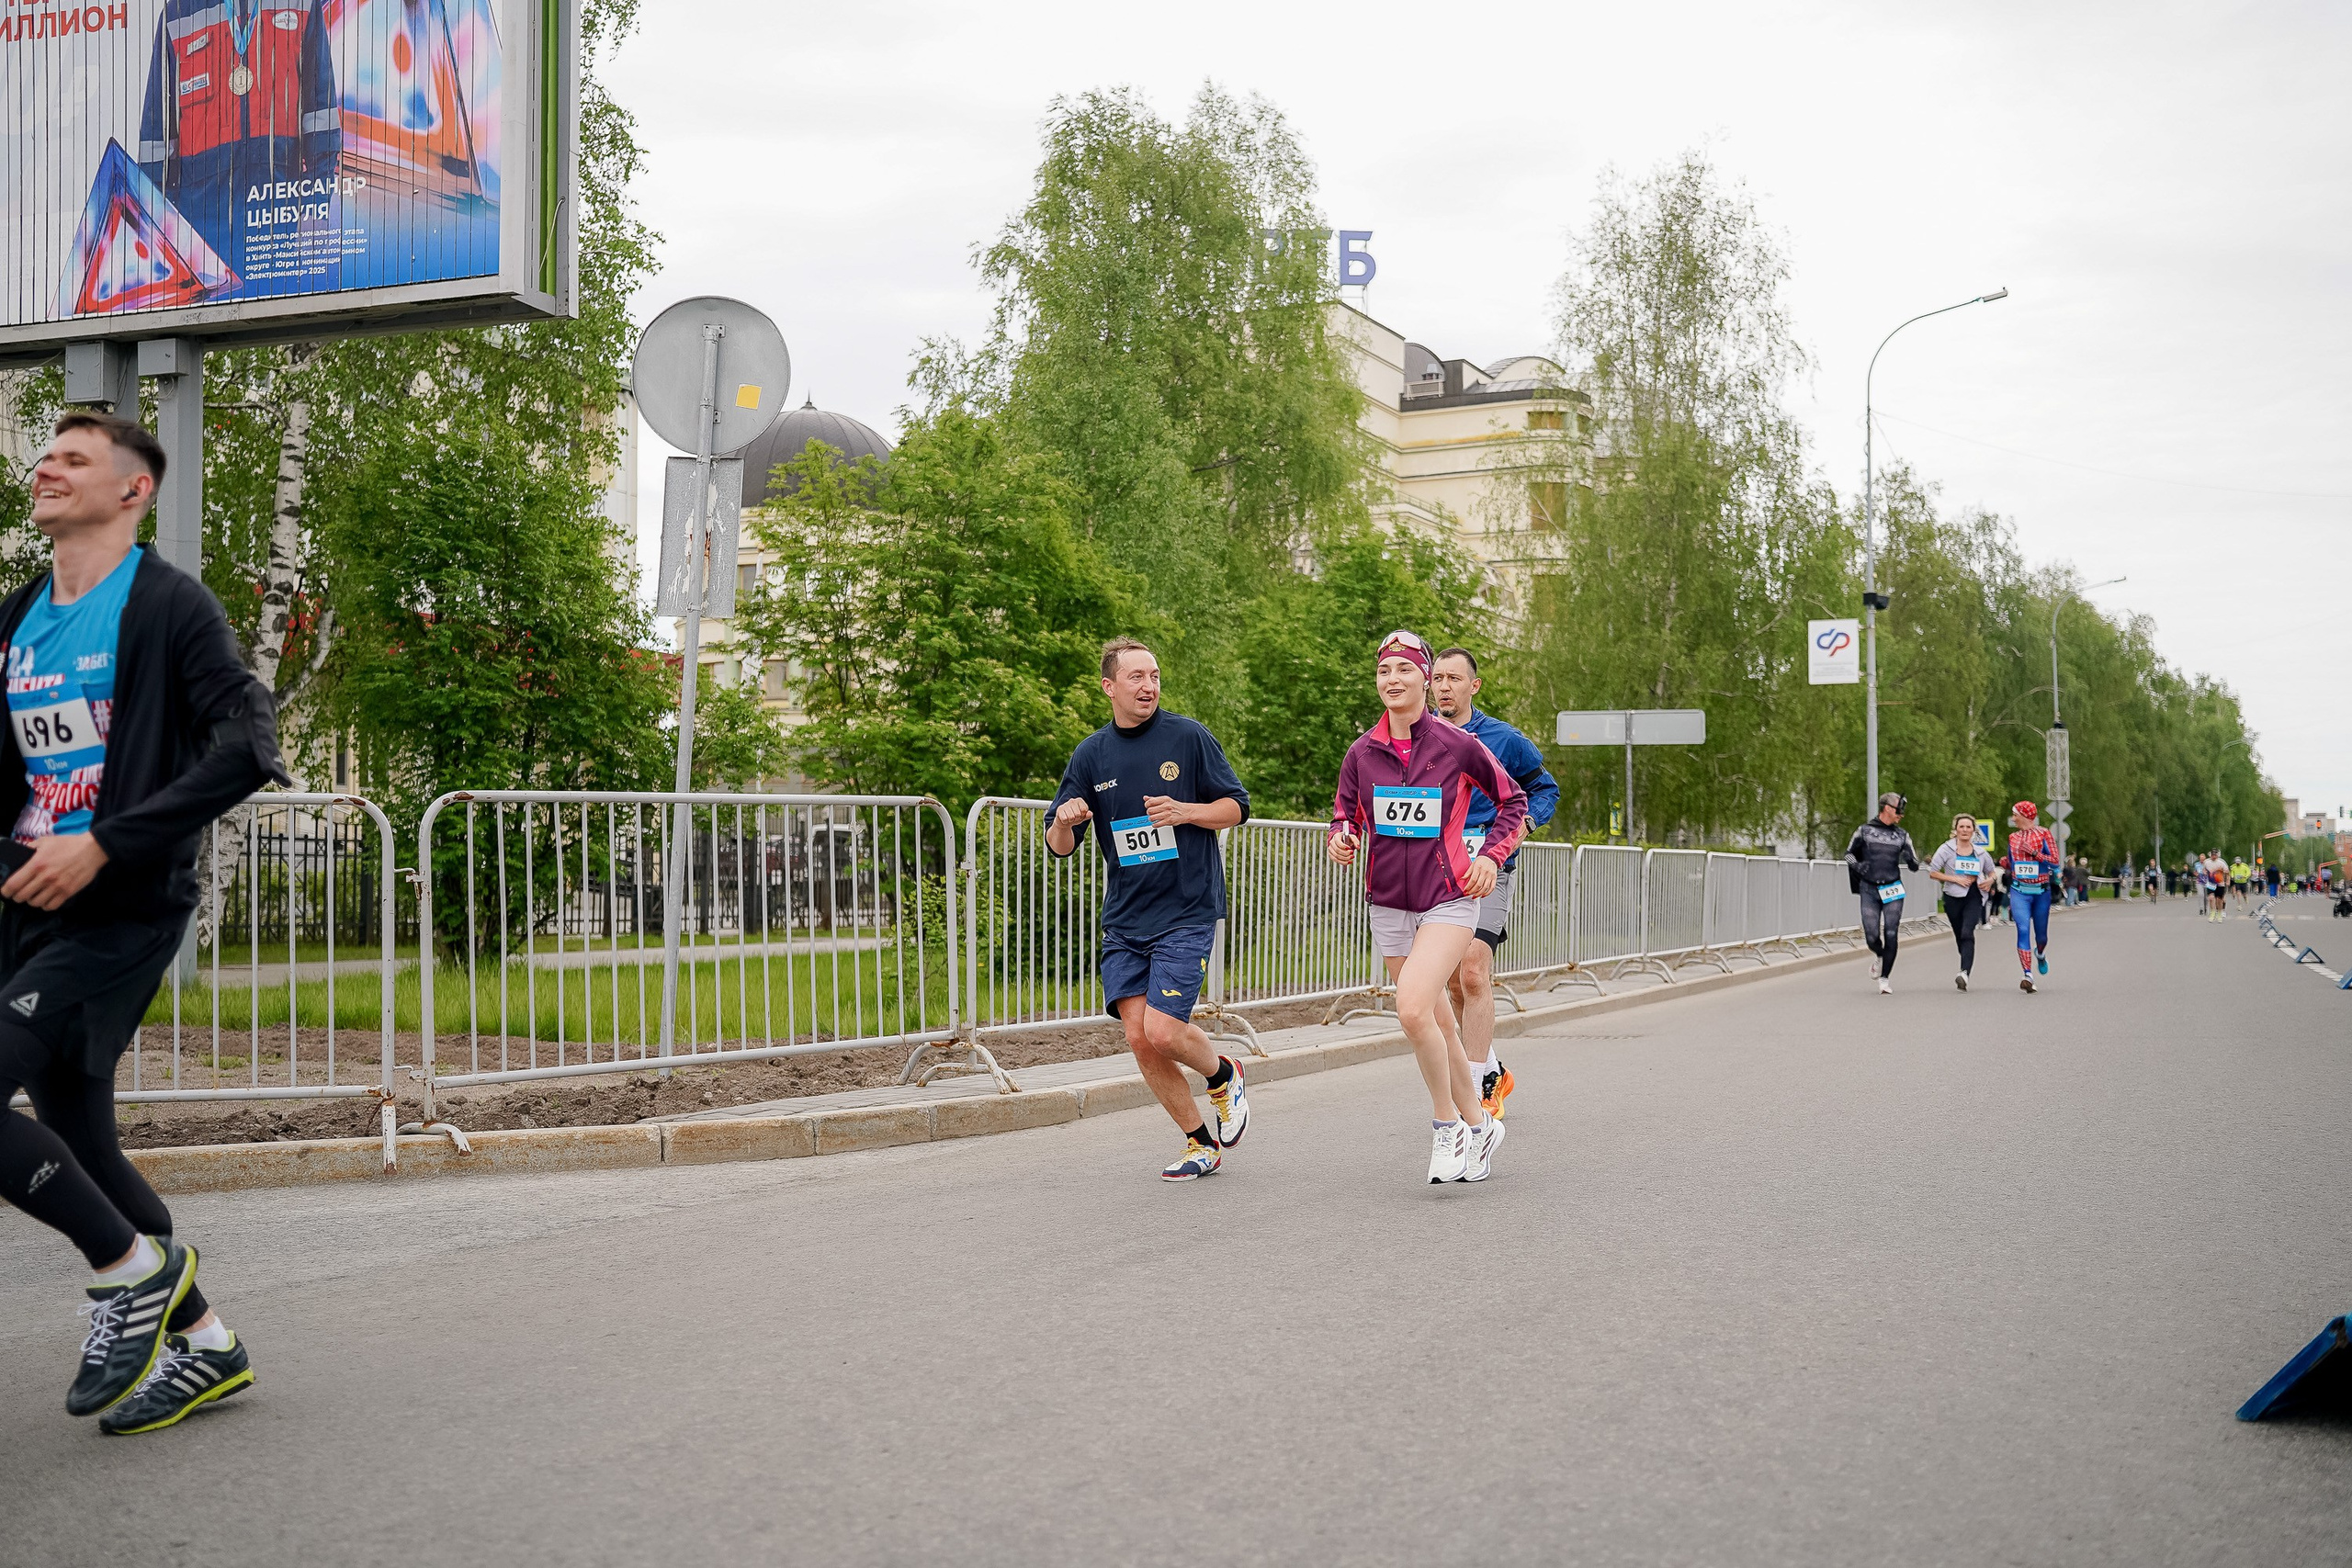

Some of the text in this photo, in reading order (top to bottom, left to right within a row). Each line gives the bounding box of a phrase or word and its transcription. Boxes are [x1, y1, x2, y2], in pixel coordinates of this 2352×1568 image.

[247, 176, 367, 202] АЛЕКСАНДР
[247, 202, 329, 229] ЦЫБУЛЯ
[344, 228, 365, 236] этапа
[245, 263, 270, 272] округе
[309, 266, 326, 275] 2025
[23, 712, 73, 749] 696
[1386, 802, 1426, 822] 676
[1125, 829, 1160, 851] 501
